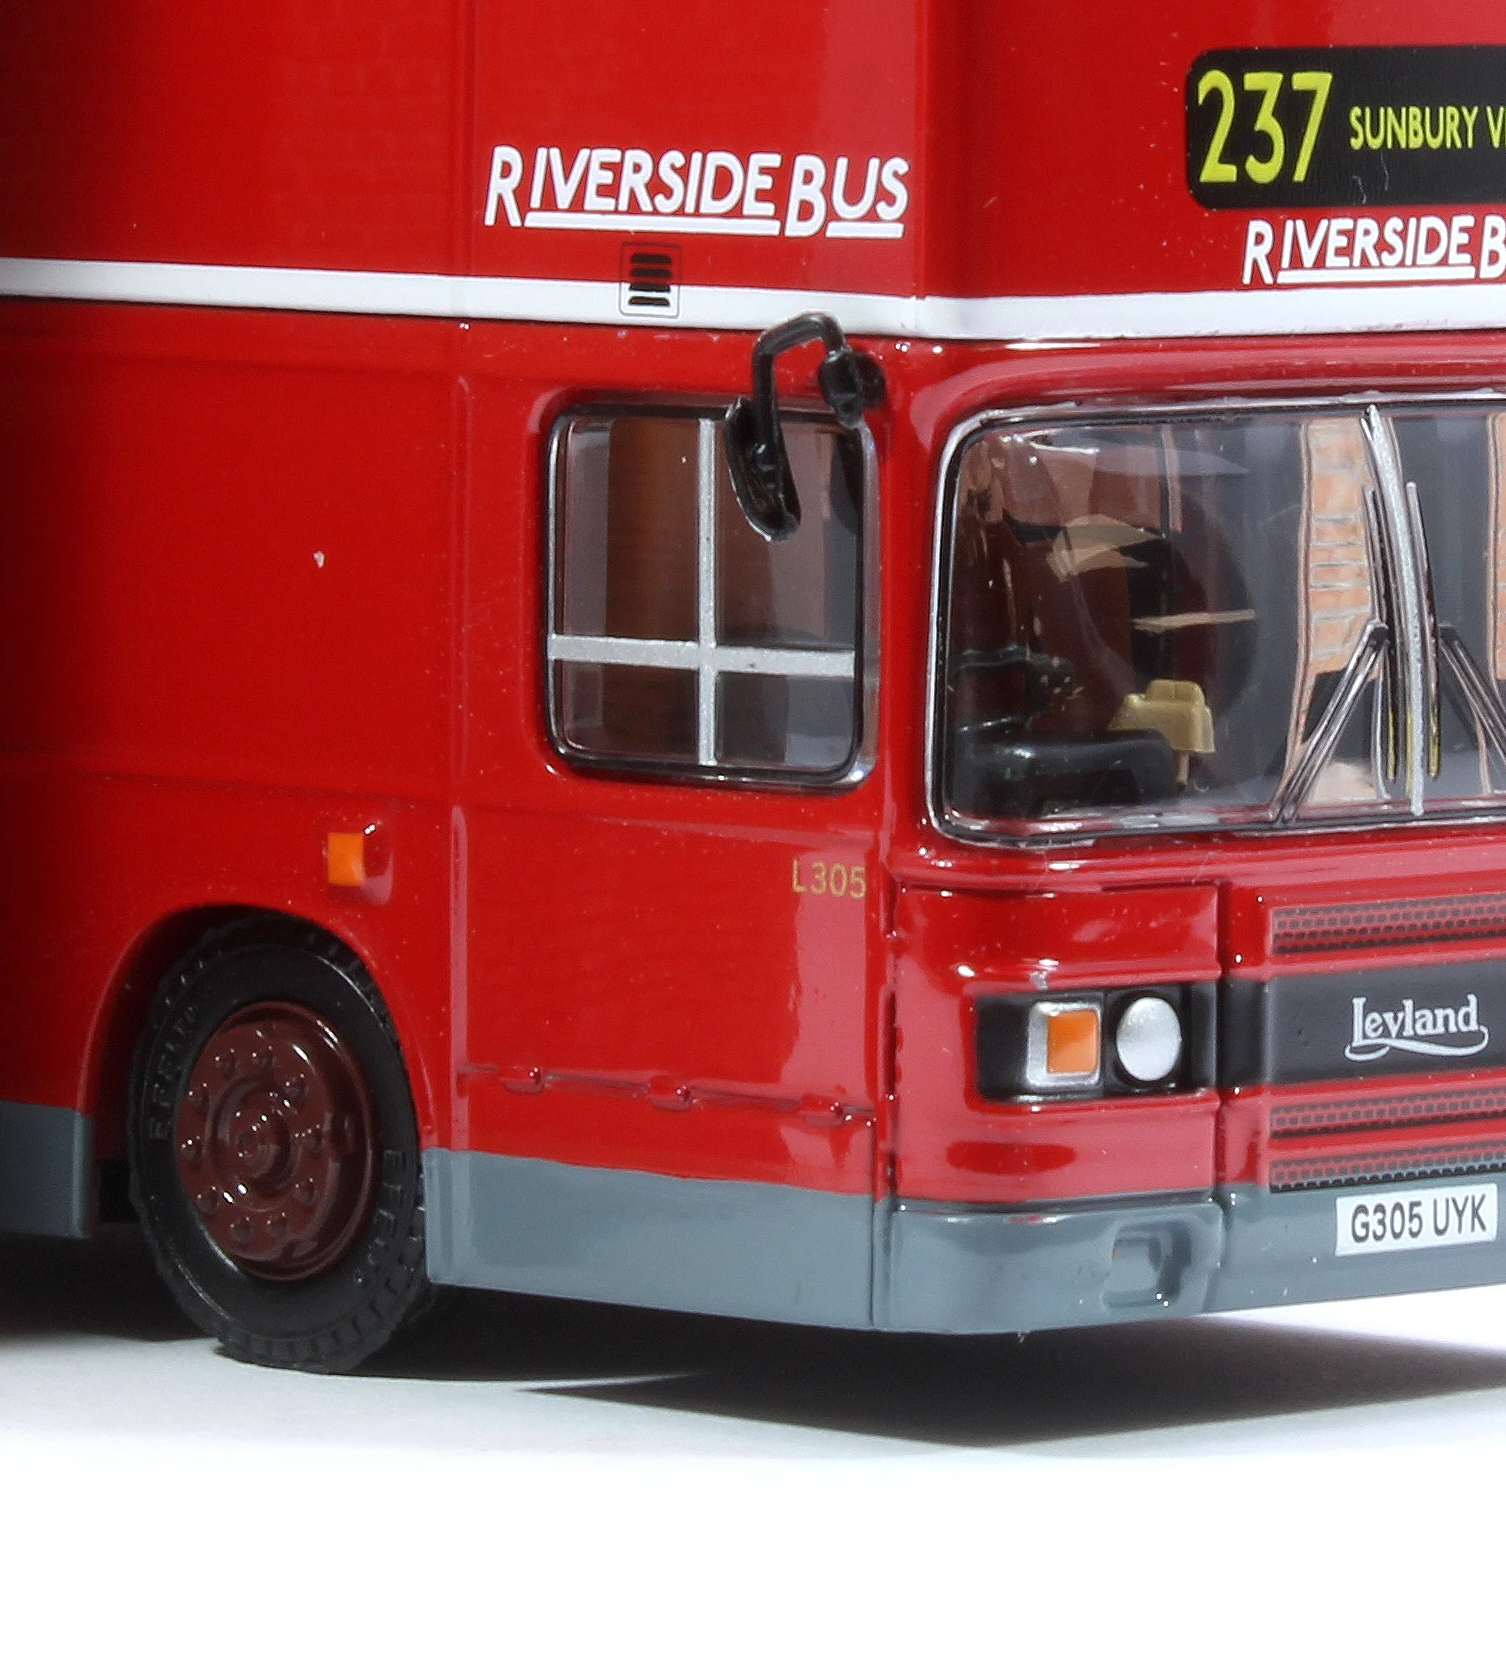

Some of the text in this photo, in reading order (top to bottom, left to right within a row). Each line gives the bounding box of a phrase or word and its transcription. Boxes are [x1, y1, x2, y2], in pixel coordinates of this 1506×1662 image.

[1197, 69, 1334, 185] 237
[1348, 105, 1480, 150] SUNBURY
[792, 858, 867, 899] L305
[1344, 993, 1490, 1062] Leyland
[1350, 1193, 1488, 1243] G305 UYK
